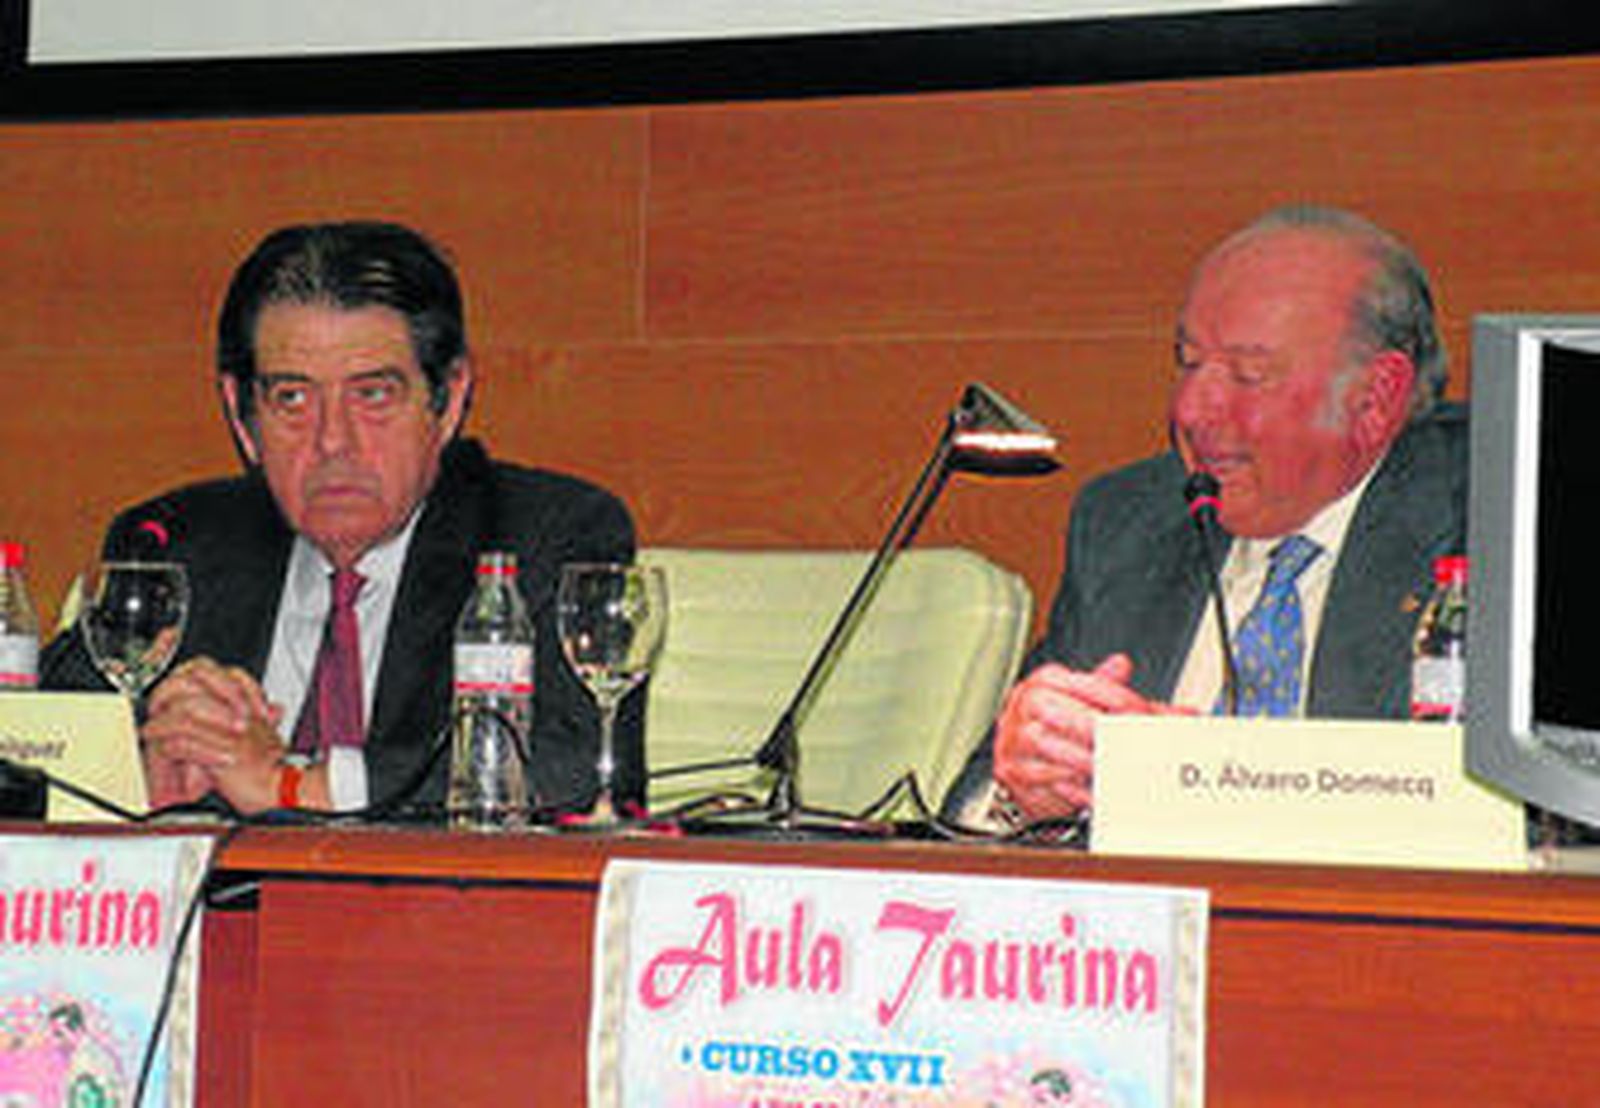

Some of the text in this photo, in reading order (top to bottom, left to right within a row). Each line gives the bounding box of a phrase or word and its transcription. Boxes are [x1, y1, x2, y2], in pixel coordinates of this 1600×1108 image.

[1180, 763, 1209, 788] D.
[1317, 768, 1434, 799] Domecq
[0, 859, 161, 949] urina
[638, 892, 1158, 1027] Aula Taurina
[700, 1041, 946, 1085] CURSO XVII
